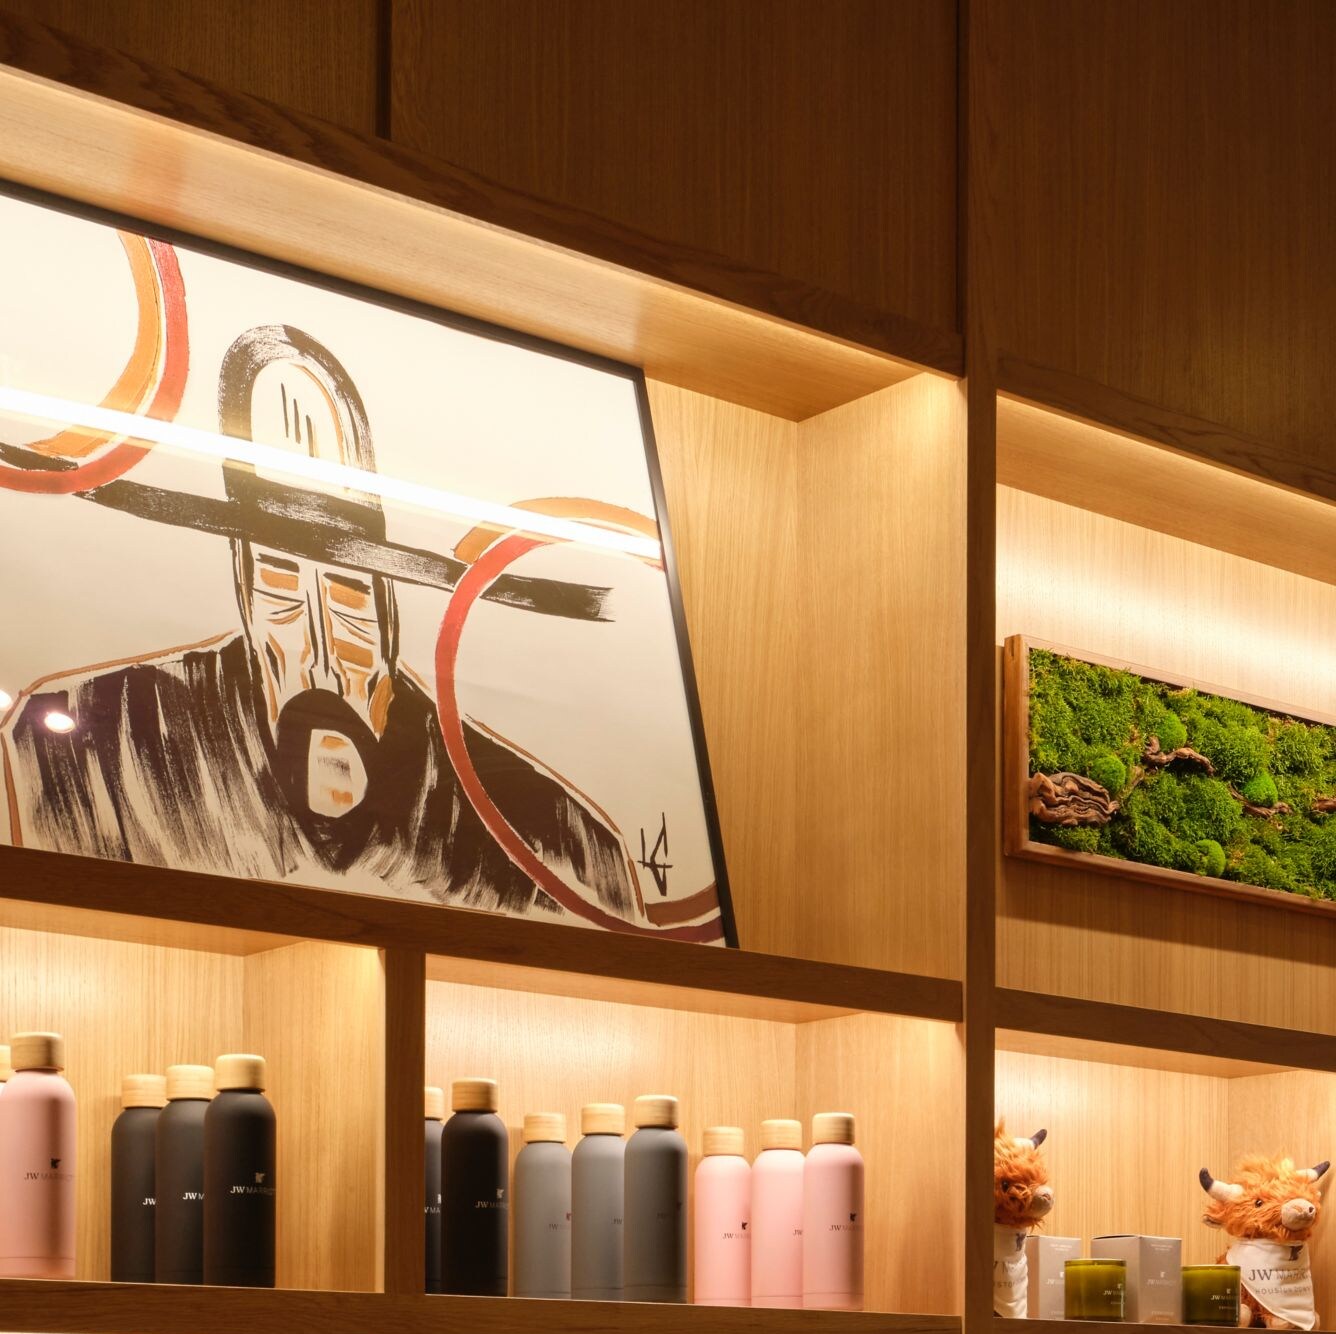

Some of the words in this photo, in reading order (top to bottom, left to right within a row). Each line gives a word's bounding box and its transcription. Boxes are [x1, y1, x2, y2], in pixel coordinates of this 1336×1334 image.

[230, 1186, 245, 1194] JW
[183, 1192, 197, 1200] JW
[1248, 1269, 1272, 1281] JW
